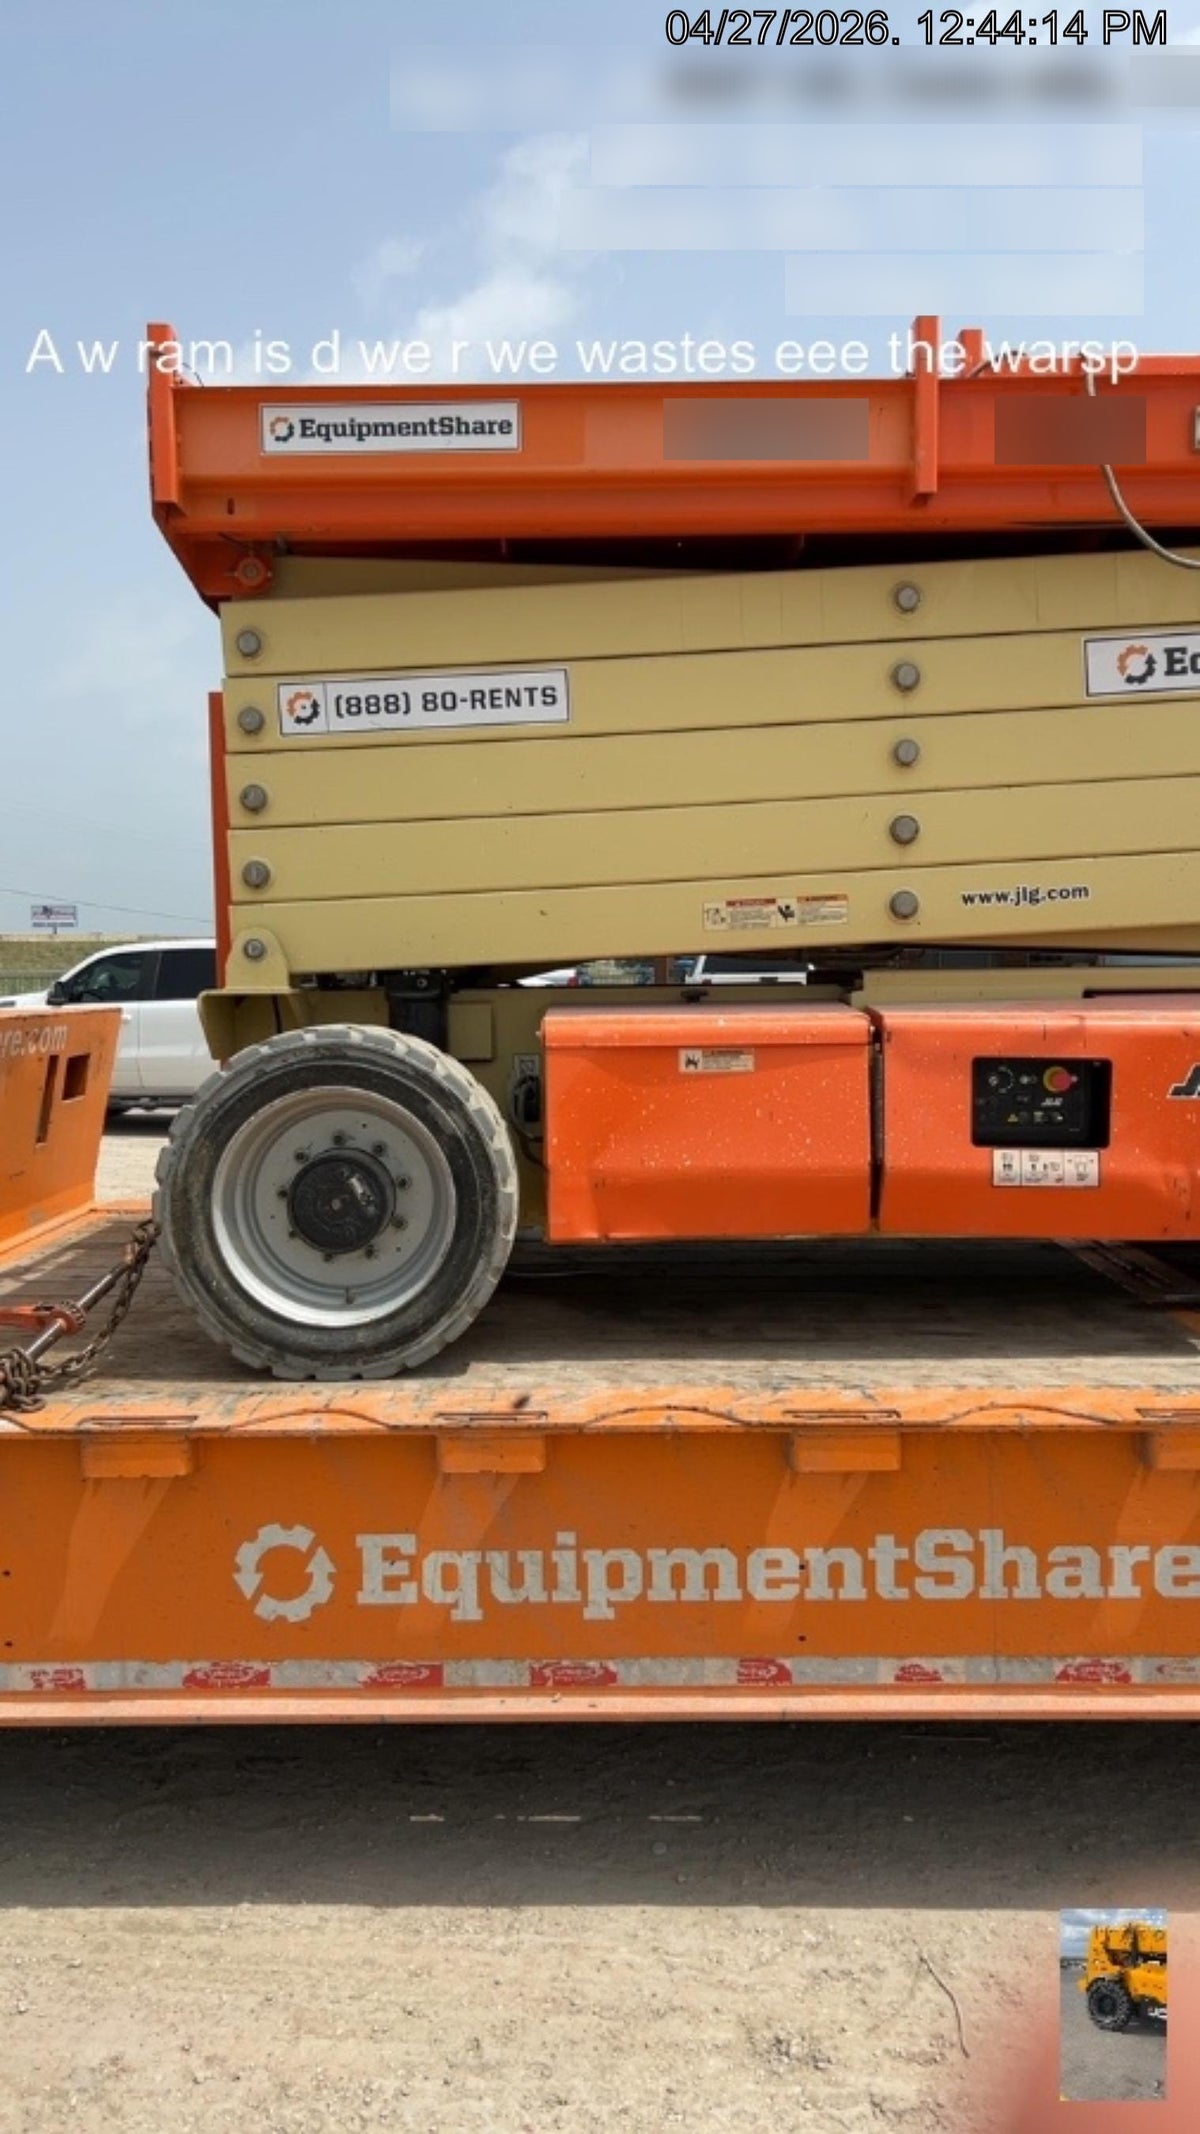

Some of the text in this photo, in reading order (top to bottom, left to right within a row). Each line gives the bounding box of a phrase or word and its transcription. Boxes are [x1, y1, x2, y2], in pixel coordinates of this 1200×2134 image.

[299, 416, 513, 443] EquipmentShare
[335, 685, 558, 718] (888) 80-RENTS
[961, 884, 1090, 906] www.jlg.com
[0, 1025, 67, 1058] re.com
[355, 1528, 1200, 1621] EquipmentShare
